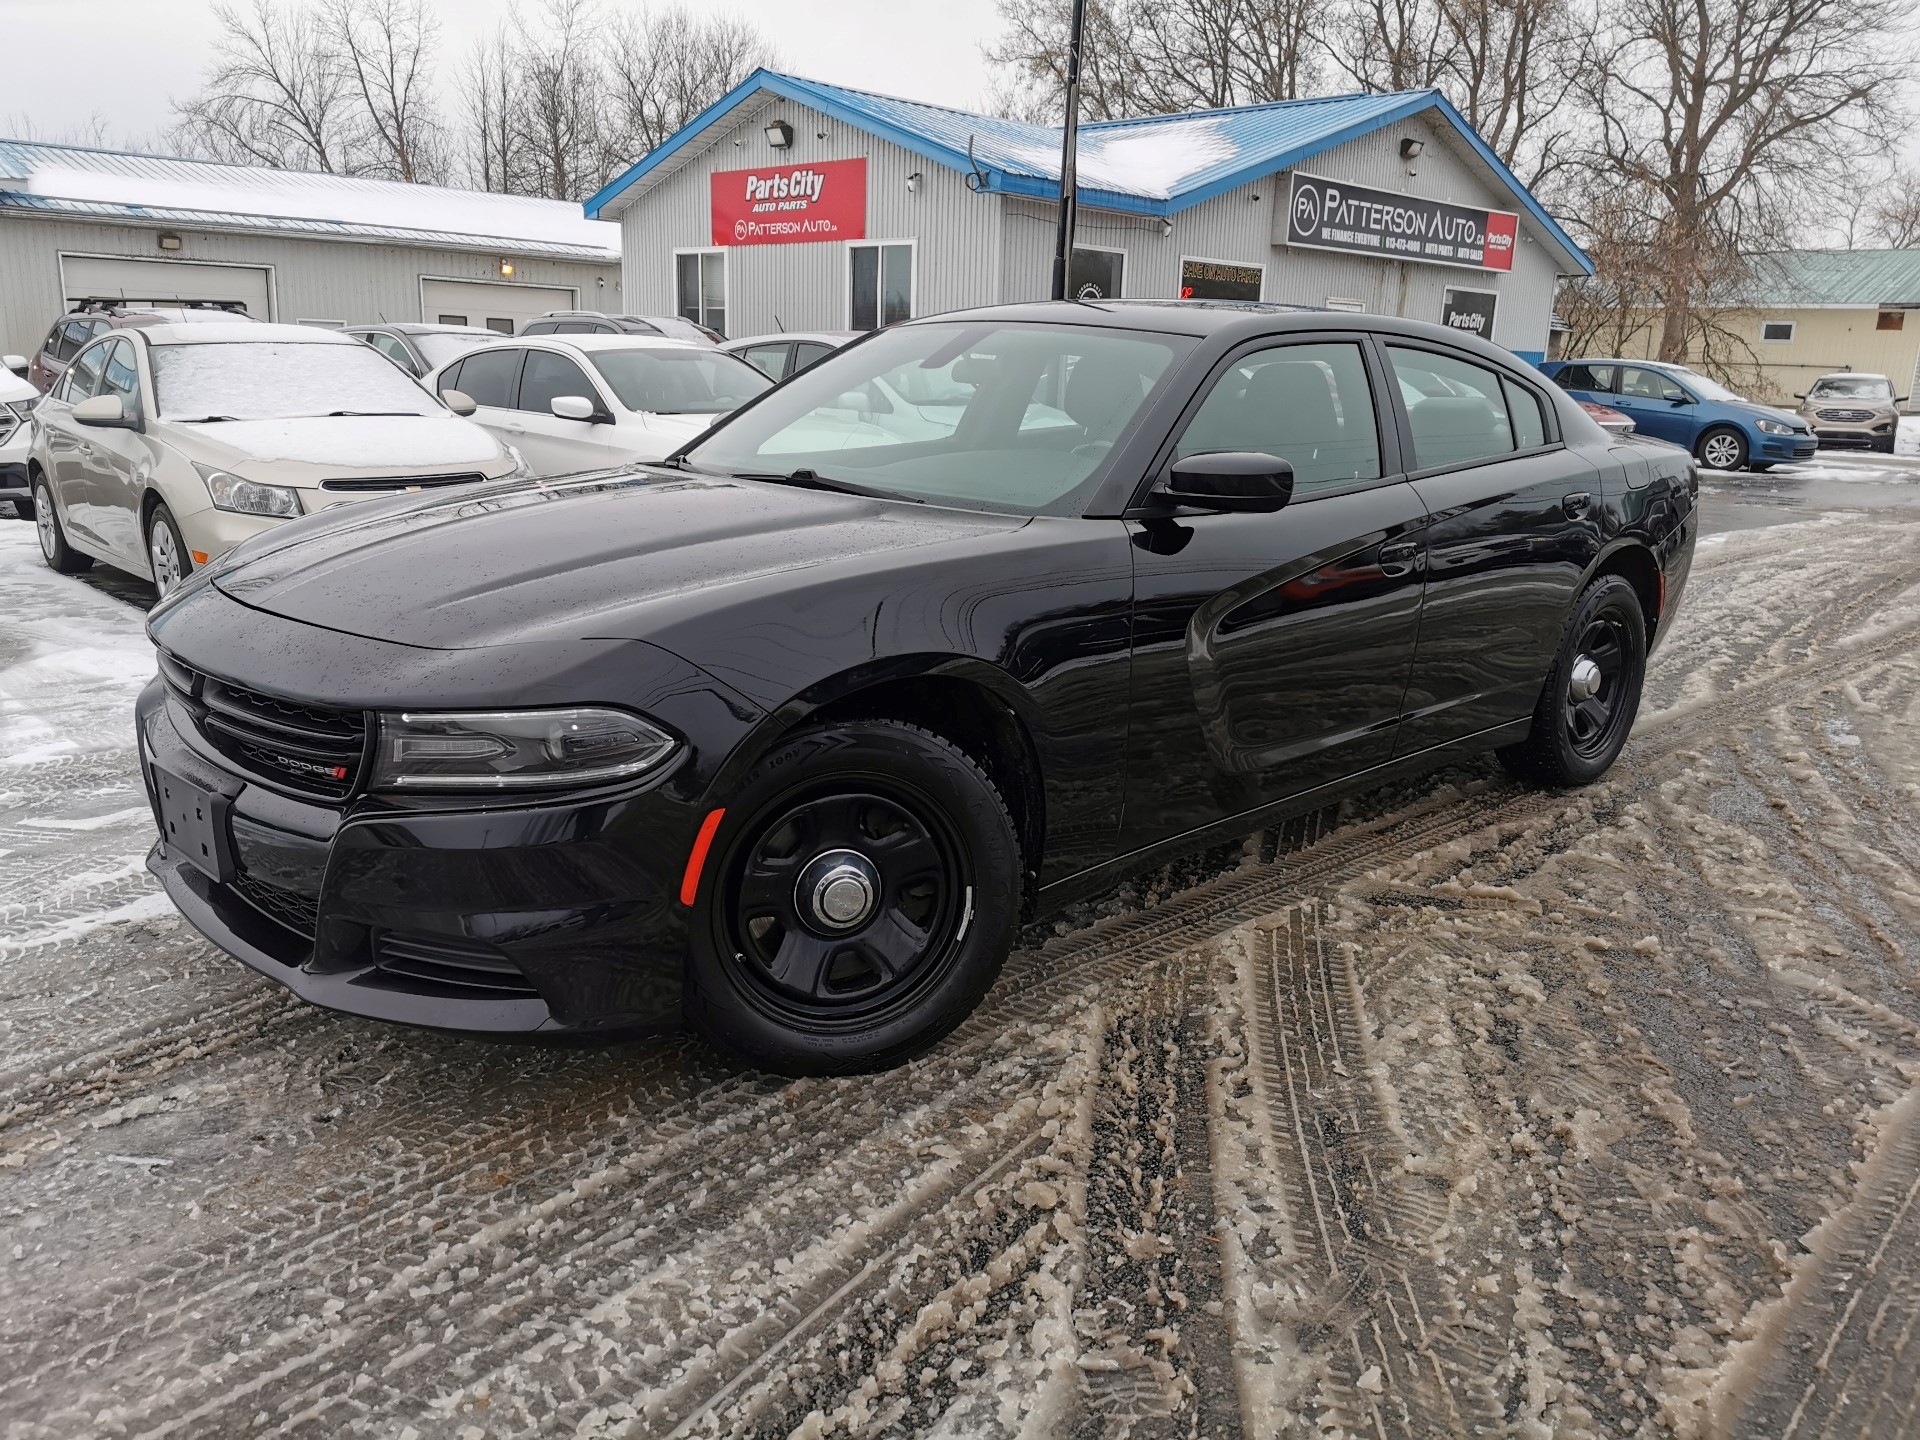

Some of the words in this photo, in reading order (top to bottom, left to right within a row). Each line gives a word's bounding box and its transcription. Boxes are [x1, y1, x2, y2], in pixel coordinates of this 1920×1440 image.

[745, 170, 824, 203] PartsCity
[752, 202, 776, 213] AUTO
[778, 200, 807, 211] PARTS
[1323, 188, 1427, 236] PATTERSON
[748, 221, 801, 235] PATTERSON
[1321, 226, 1331, 240] WE
[1331, 228, 1355, 243] FINANCE
[1354, 231, 1381, 247] EVERYONE
[1424, 242, 1438, 256] AUTO
[1438, 244, 1454, 257] PARTS
[1457, 247, 1470, 259] AUTO
[1469, 248, 1484, 262] SALES
[1448, 311, 1486, 333] PartsCity
[278, 756, 338, 776] DODGE
